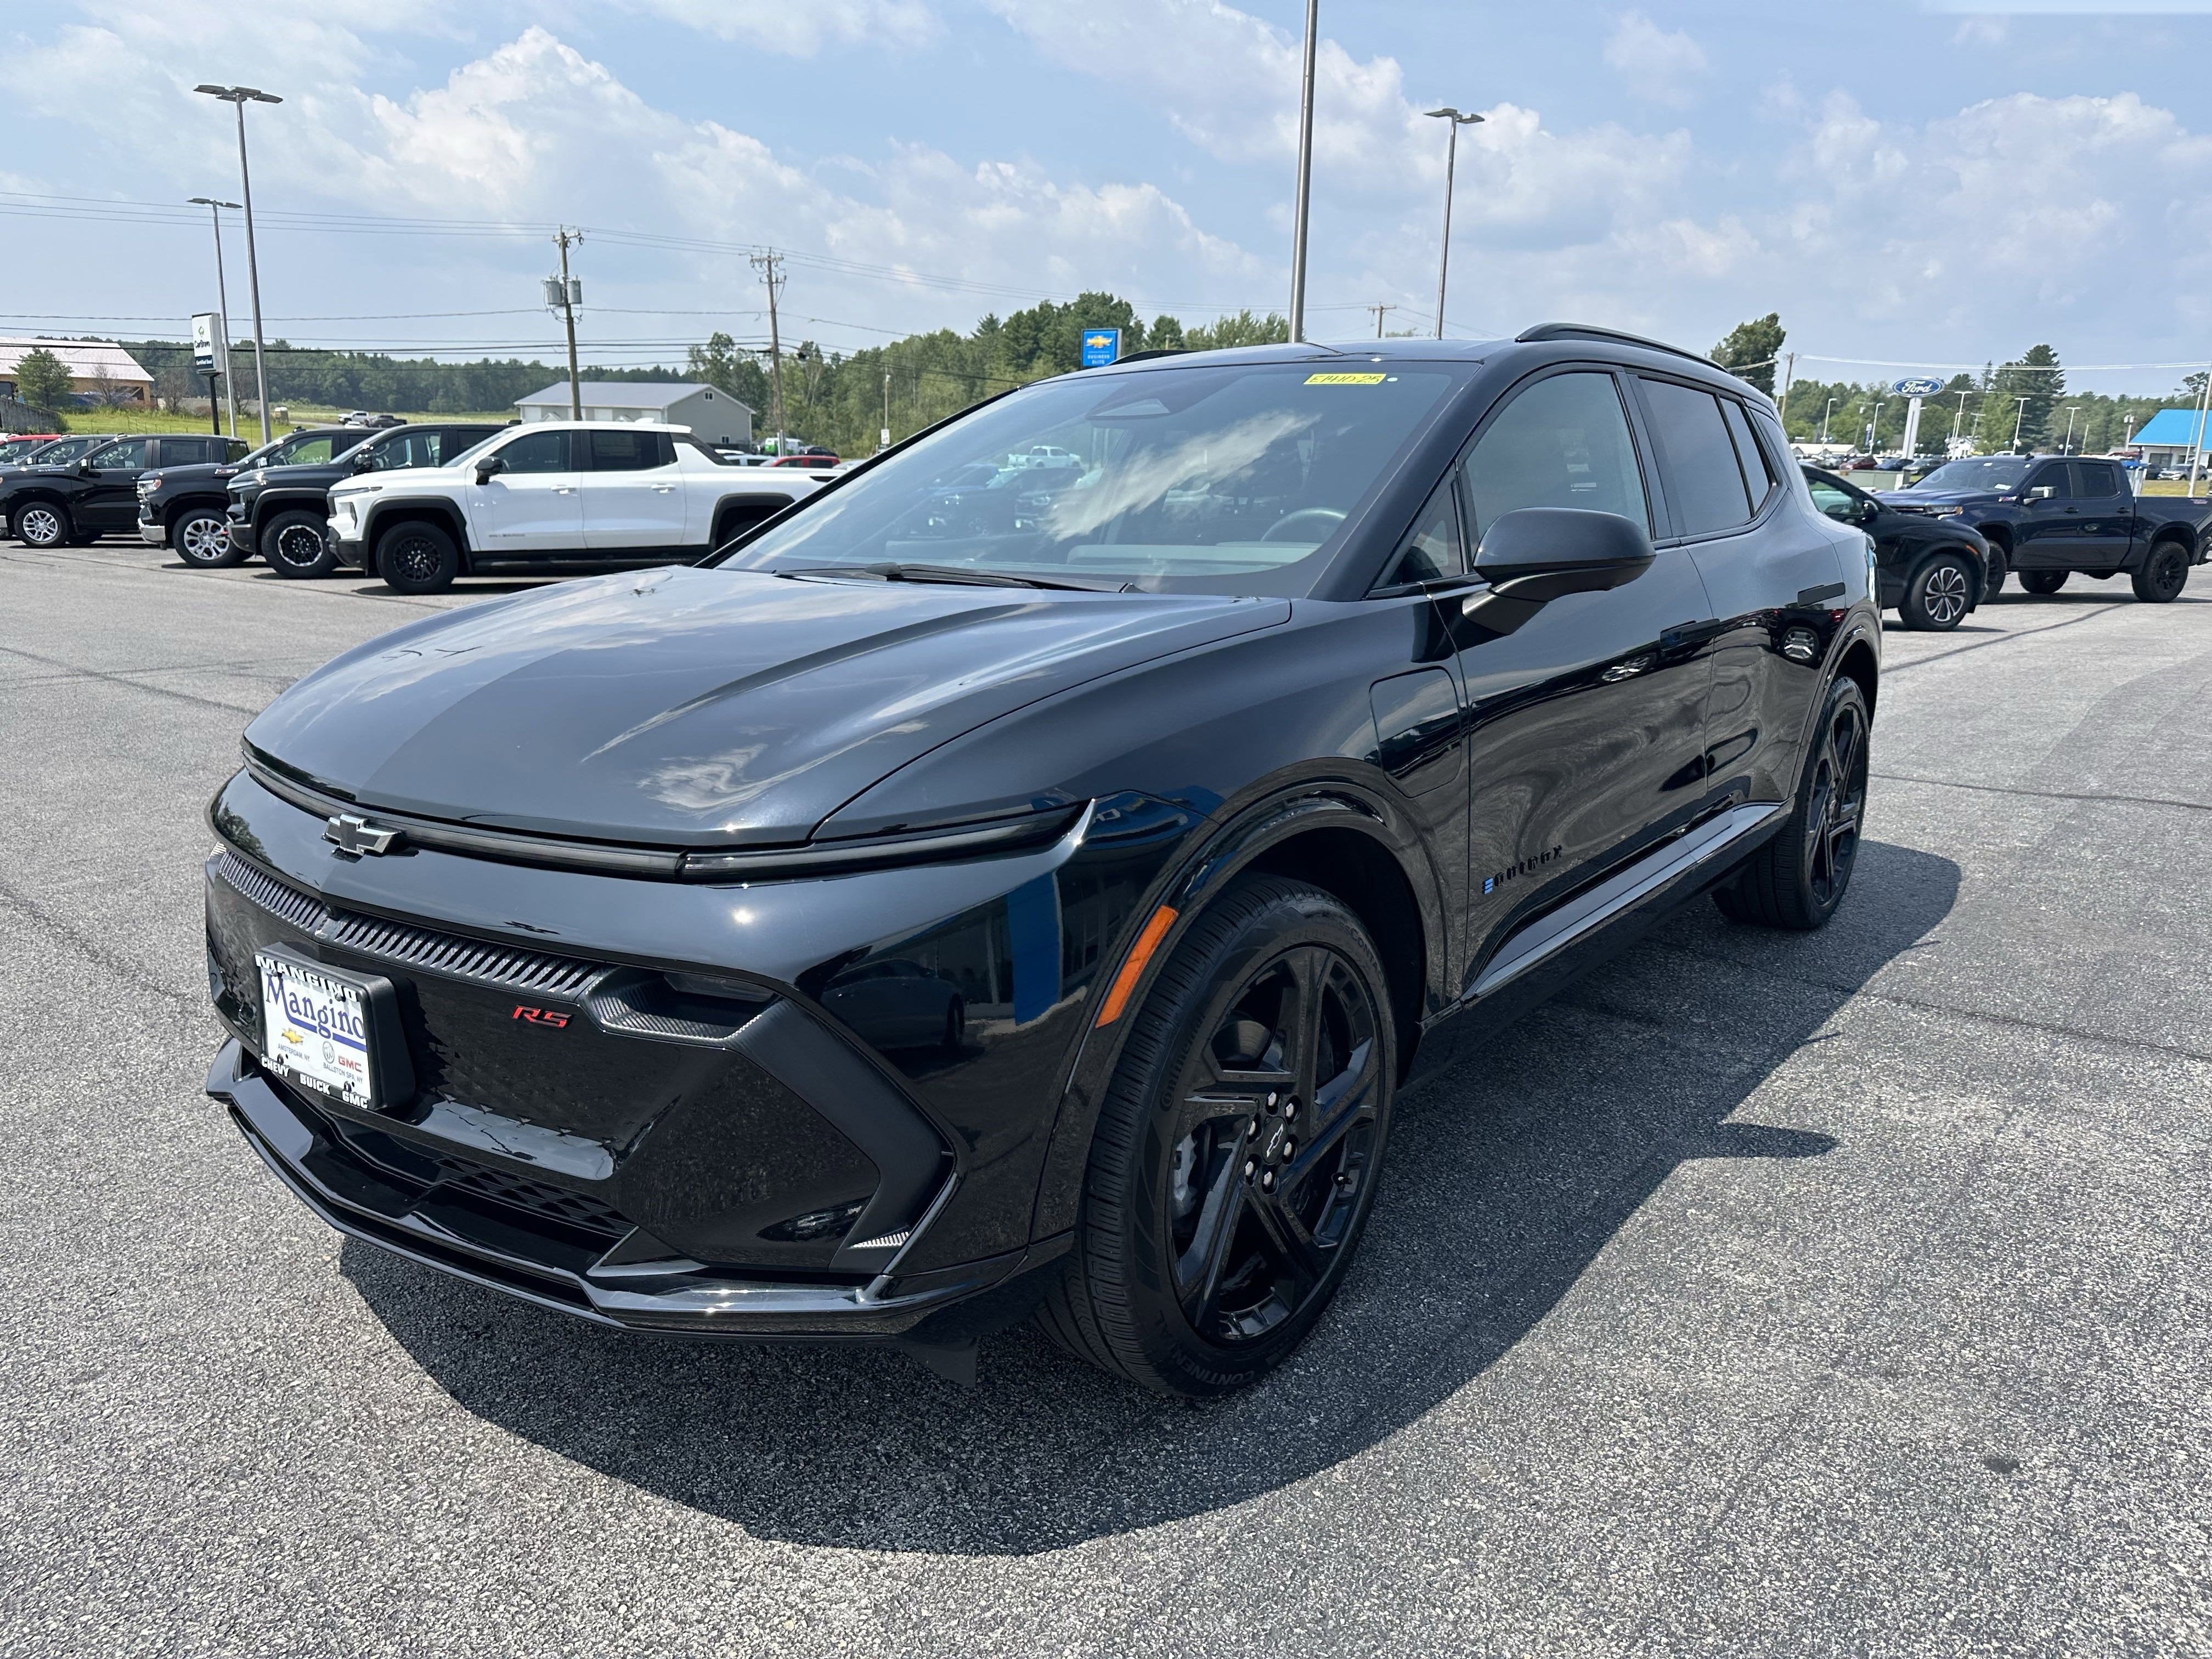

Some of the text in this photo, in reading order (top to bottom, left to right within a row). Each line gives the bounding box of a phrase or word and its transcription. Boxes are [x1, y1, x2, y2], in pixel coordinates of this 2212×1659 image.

[1901, 381, 1932, 393] Ford
[255, 955, 357, 1002] MANGINO
[266, 973, 366, 1039] Mangino
[512, 1005, 572, 1028] RS
[338, 1055, 363, 1073] GMC
[261, 1057, 368, 1109] CHEVY BUICK GMC
